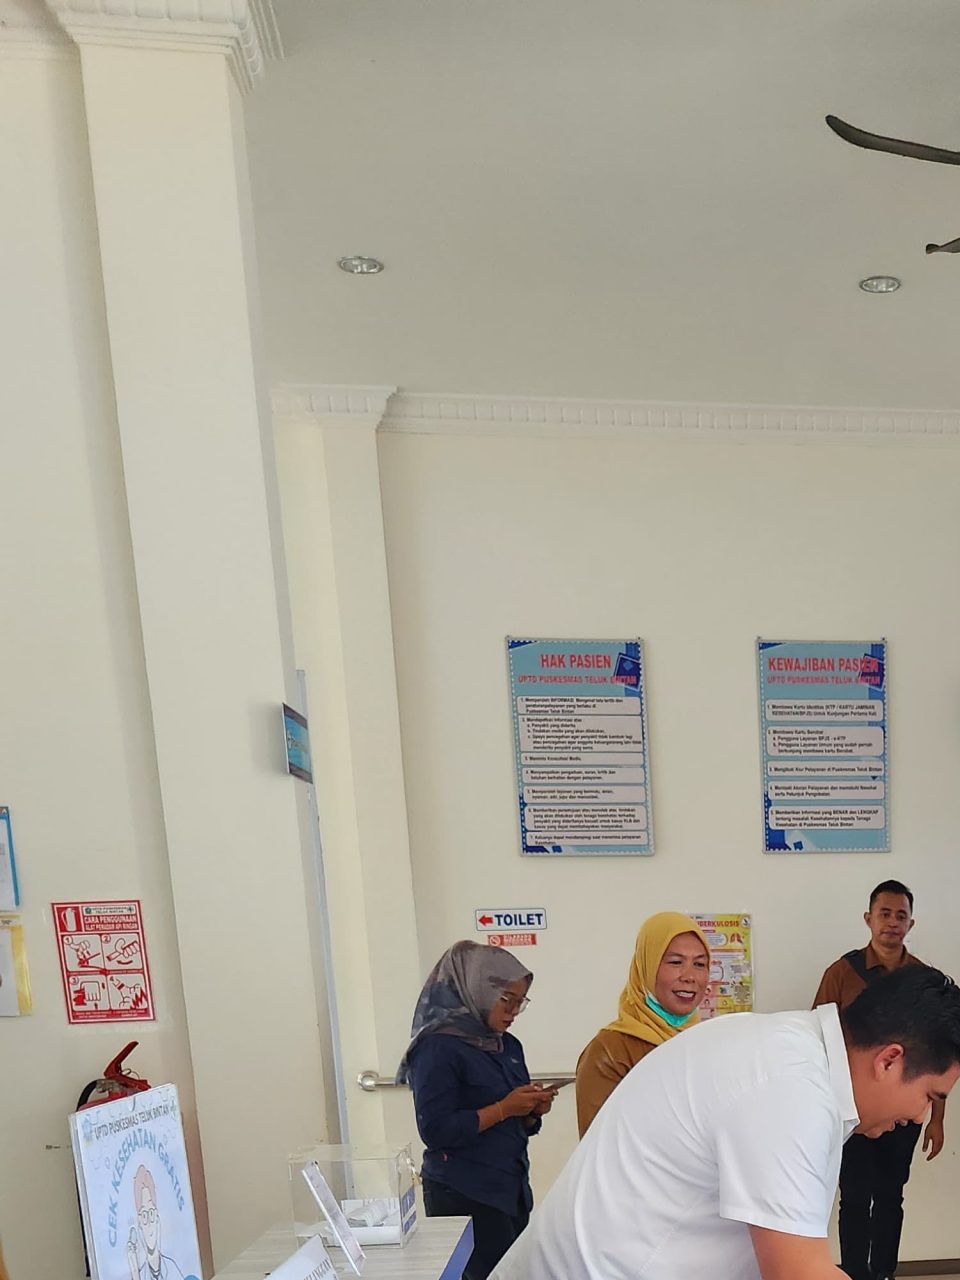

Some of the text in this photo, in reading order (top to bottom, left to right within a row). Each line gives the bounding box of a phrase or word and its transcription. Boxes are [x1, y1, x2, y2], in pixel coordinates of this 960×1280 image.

[540, 654, 611, 668] HAK PASIEN
[768, 657, 878, 672] KEWAJIBAN PASIEN
[494, 914, 543, 926] TOILET
[94, 1126, 108, 1139] UPTD
[108, 1114, 139, 1135] PUSKESMAS
[154, 1106, 169, 1120] BINTAN
[108, 1128, 185, 1247] CEK KESEHATAN GRATIS
